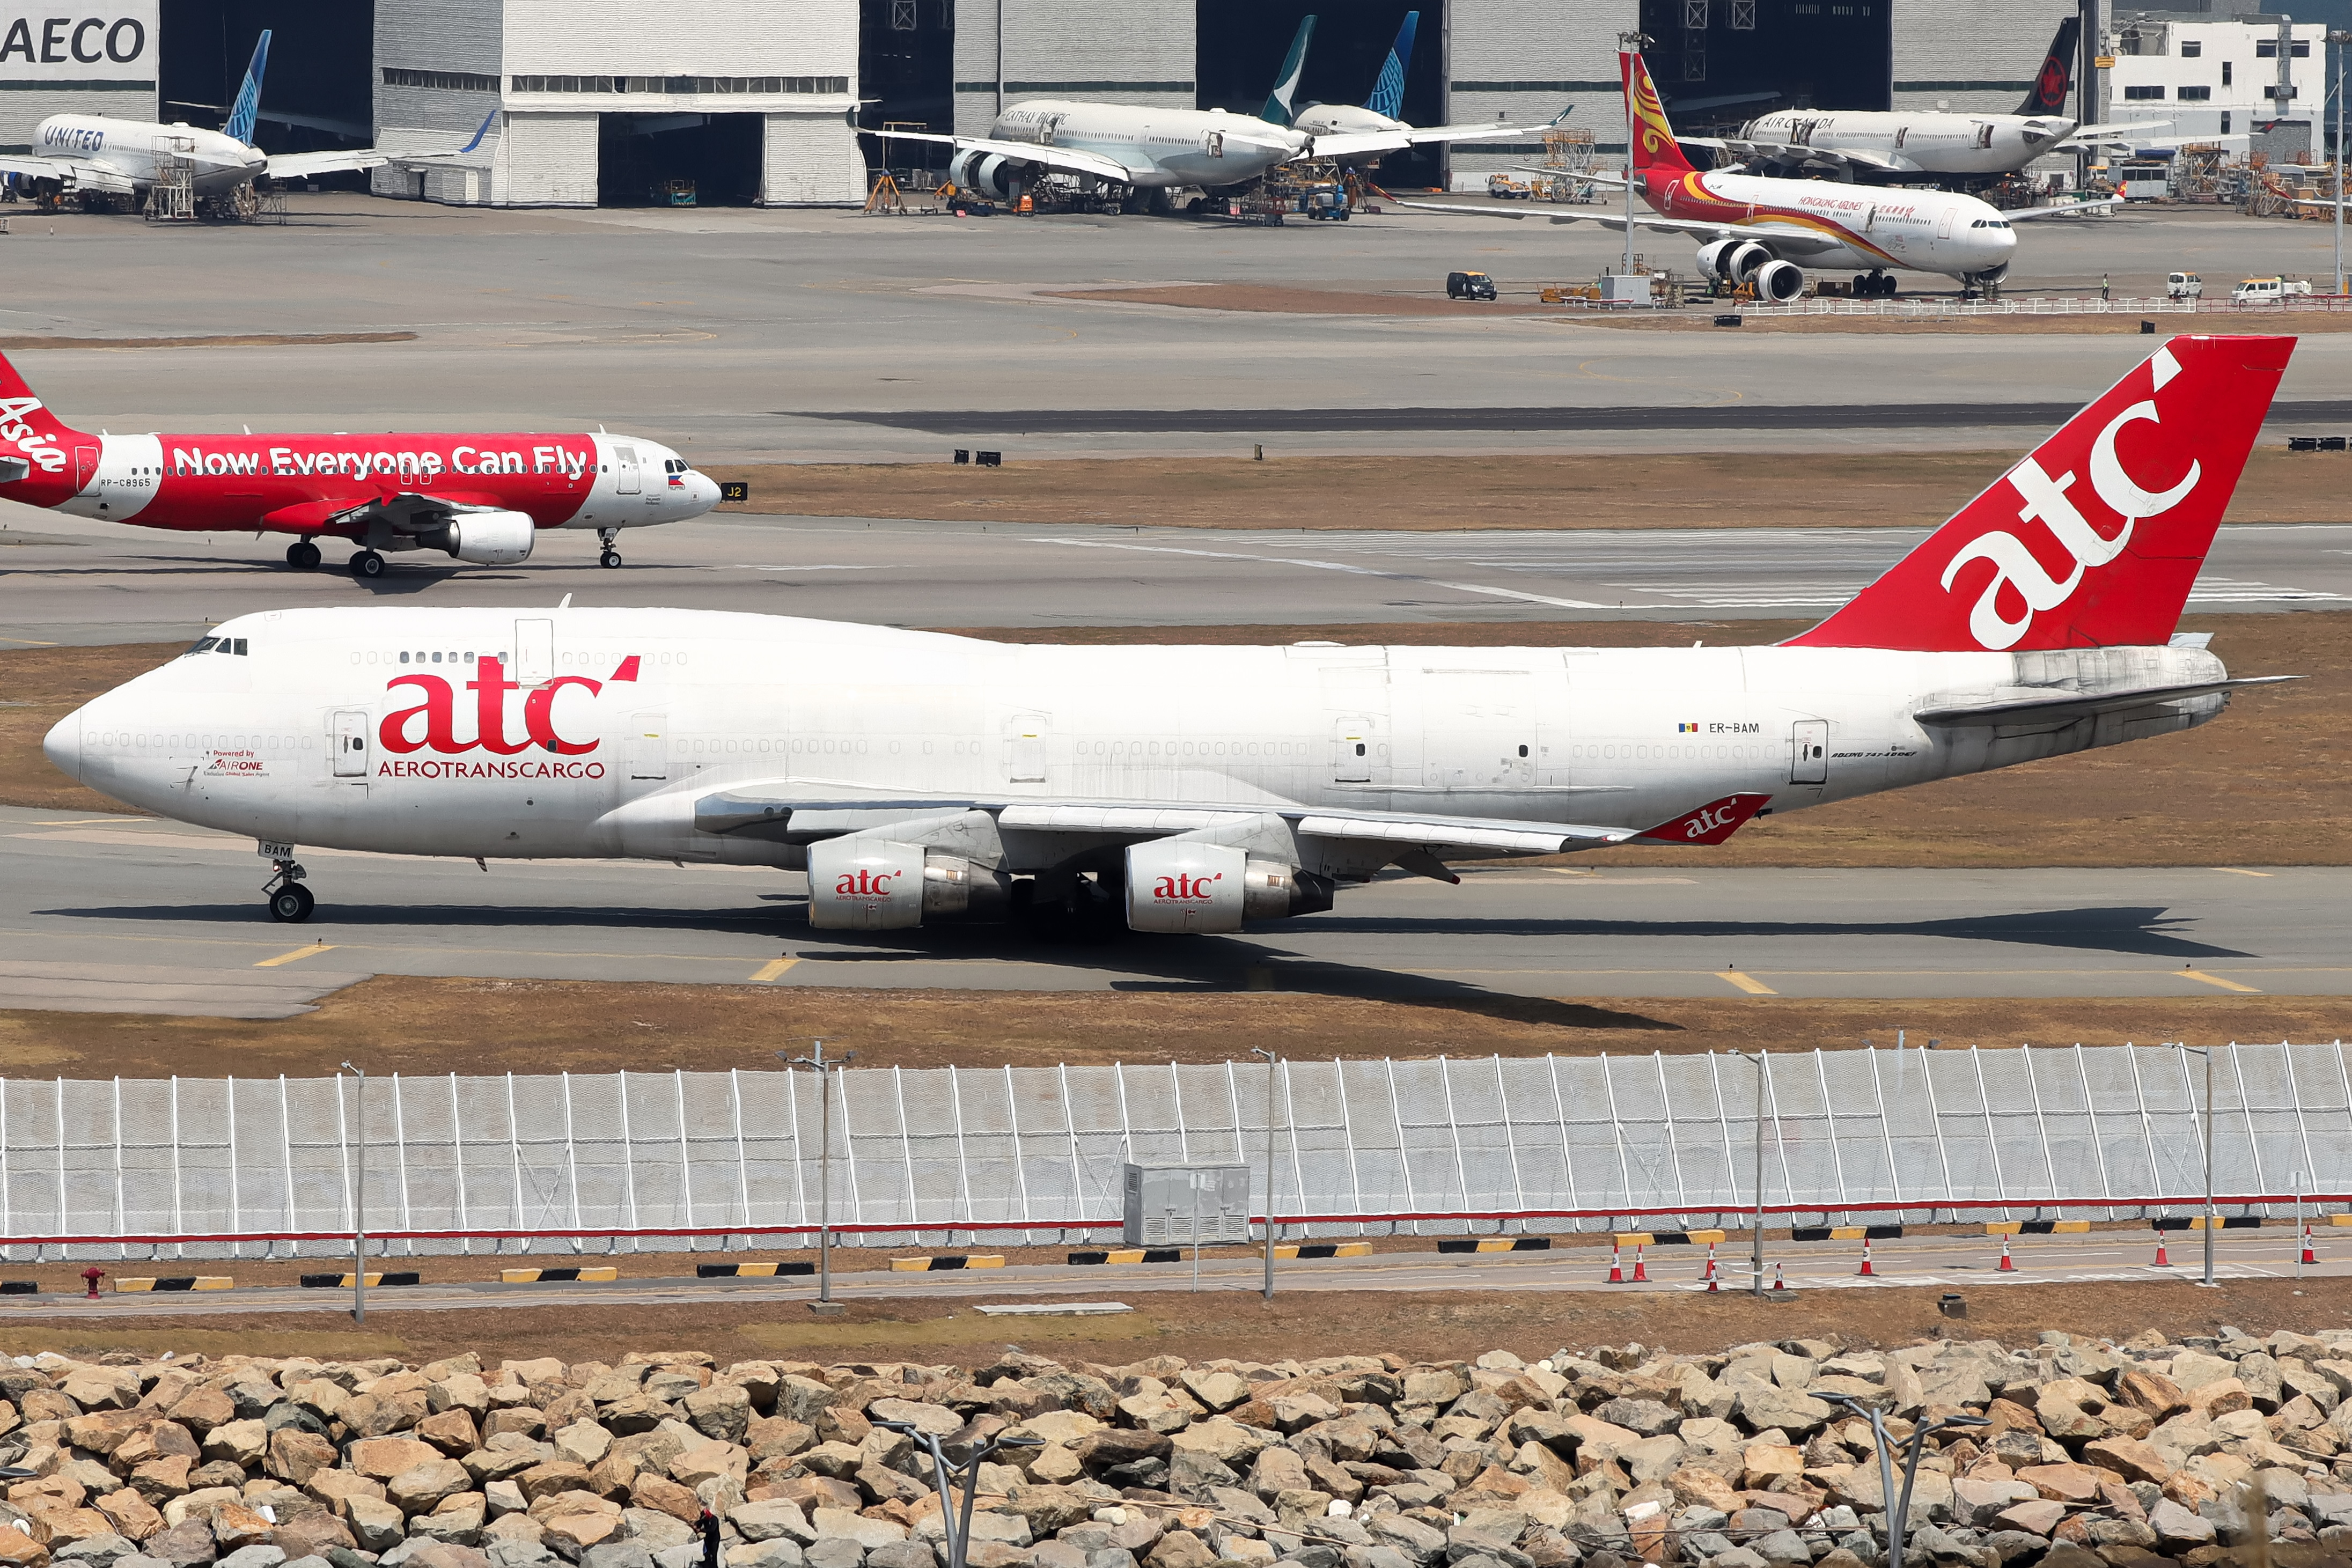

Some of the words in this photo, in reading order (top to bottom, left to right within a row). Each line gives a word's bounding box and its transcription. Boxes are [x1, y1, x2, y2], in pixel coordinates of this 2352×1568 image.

[0, 18, 144, 63] AECO
[1005, 111, 1035, 123] CATHAY
[1762, 117, 1785, 128] AIR
[45, 125, 104, 151] UNITED
[173, 447, 259, 476] Now
[269, 447, 442, 481] Everyone
[452, 446, 521, 475] Can
[533, 445, 587, 480] Fly
[101, 478, 151, 487] RP-C8965
[727, 487, 741, 497] J2
[1710, 723, 1759, 733] ER-BAM
[246, 750, 255, 758] by
[378, 760, 605, 779] AEROTRANSCARGO
[264, 844, 291, 857] BAM
